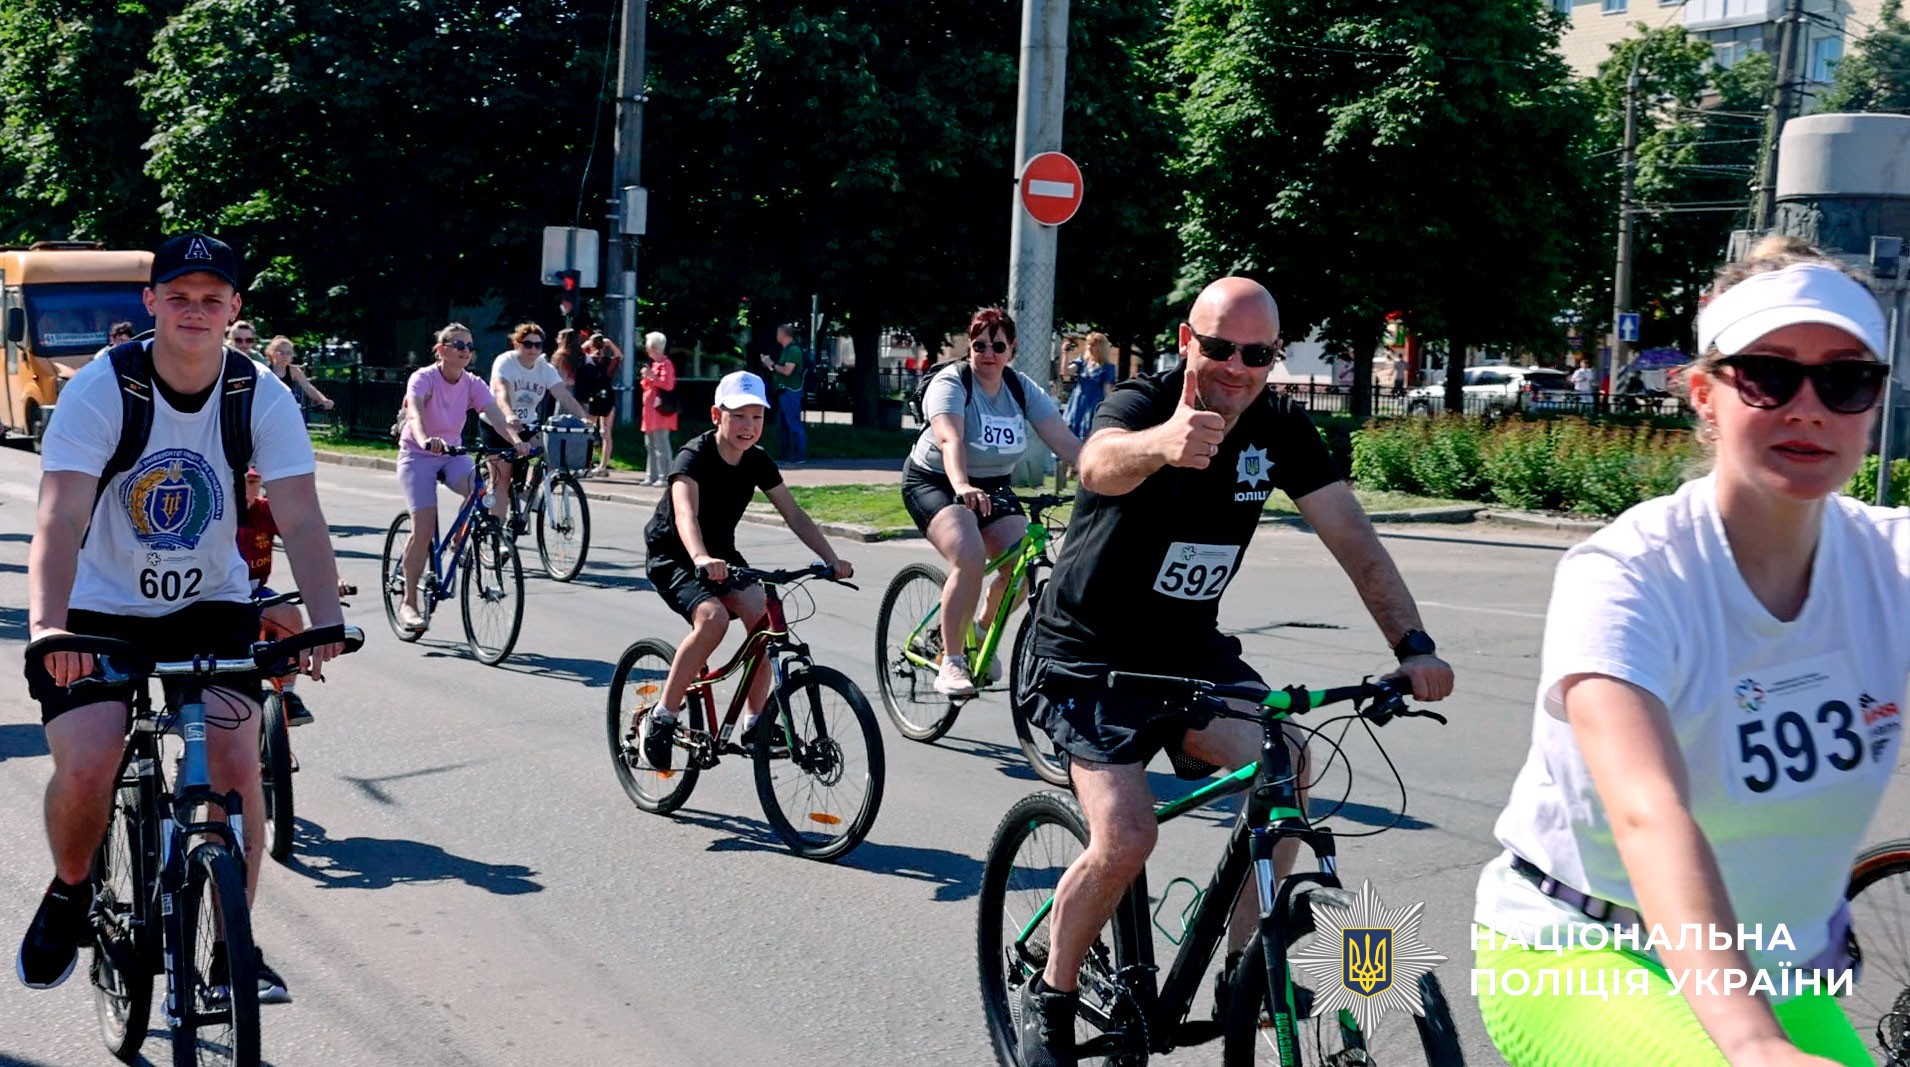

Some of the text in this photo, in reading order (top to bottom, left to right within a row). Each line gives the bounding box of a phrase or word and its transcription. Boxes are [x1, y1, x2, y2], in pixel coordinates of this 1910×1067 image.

[185, 238, 212, 260] A
[984, 425, 1015, 445] 879
[1234, 490, 1269, 502] ОЛІЦ
[140, 567, 203, 601] 602
[1160, 561, 1228, 596] 592
[1737, 700, 1863, 793] 593
